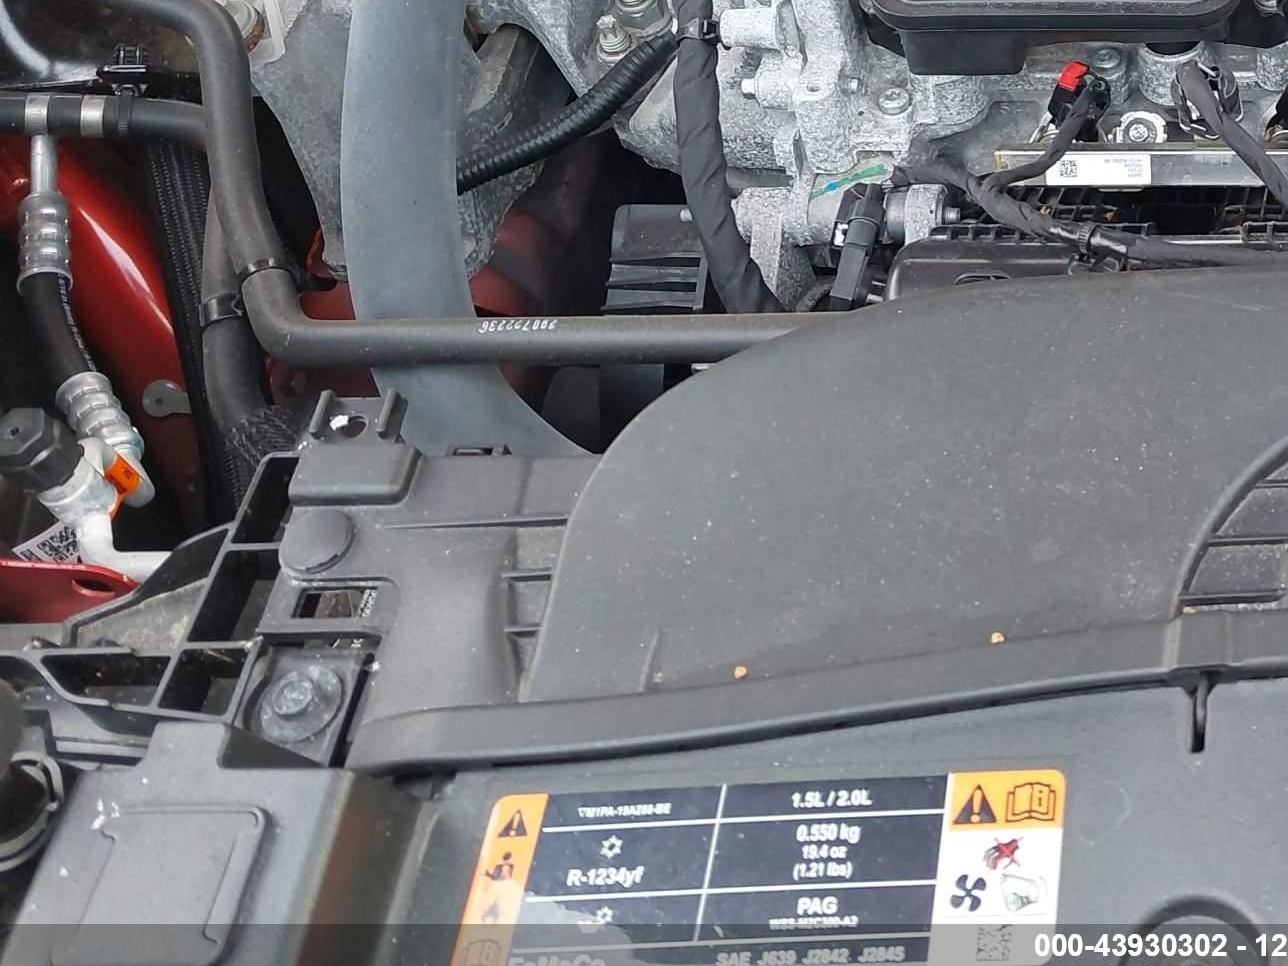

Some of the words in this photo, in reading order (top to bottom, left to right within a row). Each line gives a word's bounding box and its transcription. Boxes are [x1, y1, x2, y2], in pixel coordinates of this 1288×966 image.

[792, 791, 825, 808] 1.5L
[836, 789, 872, 807] 2.0L
[796, 823, 838, 842] 0.550
[839, 823, 862, 844] kg
[802, 844, 829, 859] 19.4
[830, 846, 847, 859] oz
[566, 866, 645, 887] R-1234yf
[793, 863, 825, 881] (1.21
[826, 861, 853, 878] lbs)
[797, 896, 838, 914] PAG
